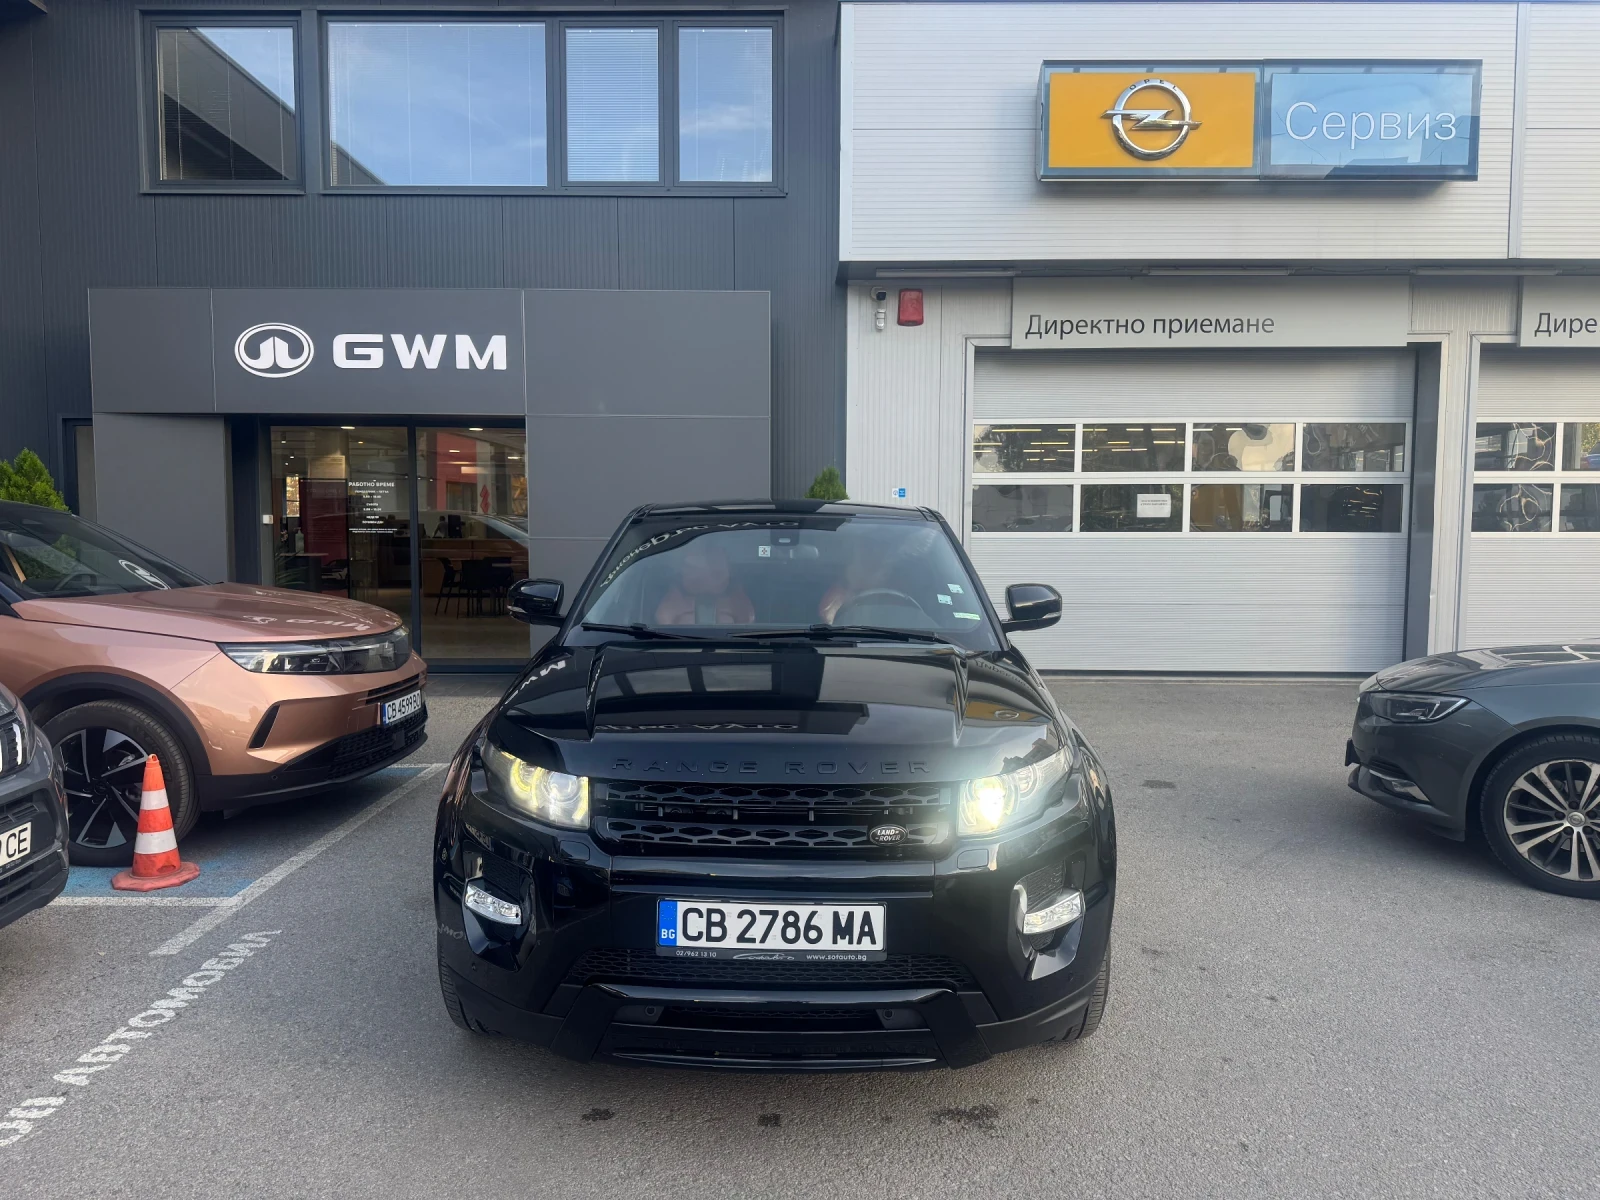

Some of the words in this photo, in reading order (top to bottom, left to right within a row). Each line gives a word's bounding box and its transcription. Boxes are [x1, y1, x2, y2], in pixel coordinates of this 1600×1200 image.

[1129, 78, 1177, 92] OPEL
[1285, 101, 1457, 150] Сервиз
[1025, 314, 1145, 340] Директно
[1152, 317, 1275, 339] приемане
[1534, 312, 1598, 338] Дире
[333, 333, 507, 370] GWM
[612, 757, 758, 774] RANGE
[784, 760, 931, 775] ROVER
[6, 827, 28, 858] CE
[661, 928, 676, 939] BG
[682, 907, 728, 943] CB
[736, 909, 824, 945] 2786
[832, 910, 877, 945] MA
[53, 929, 283, 1086] АВТОМОБИЛ
